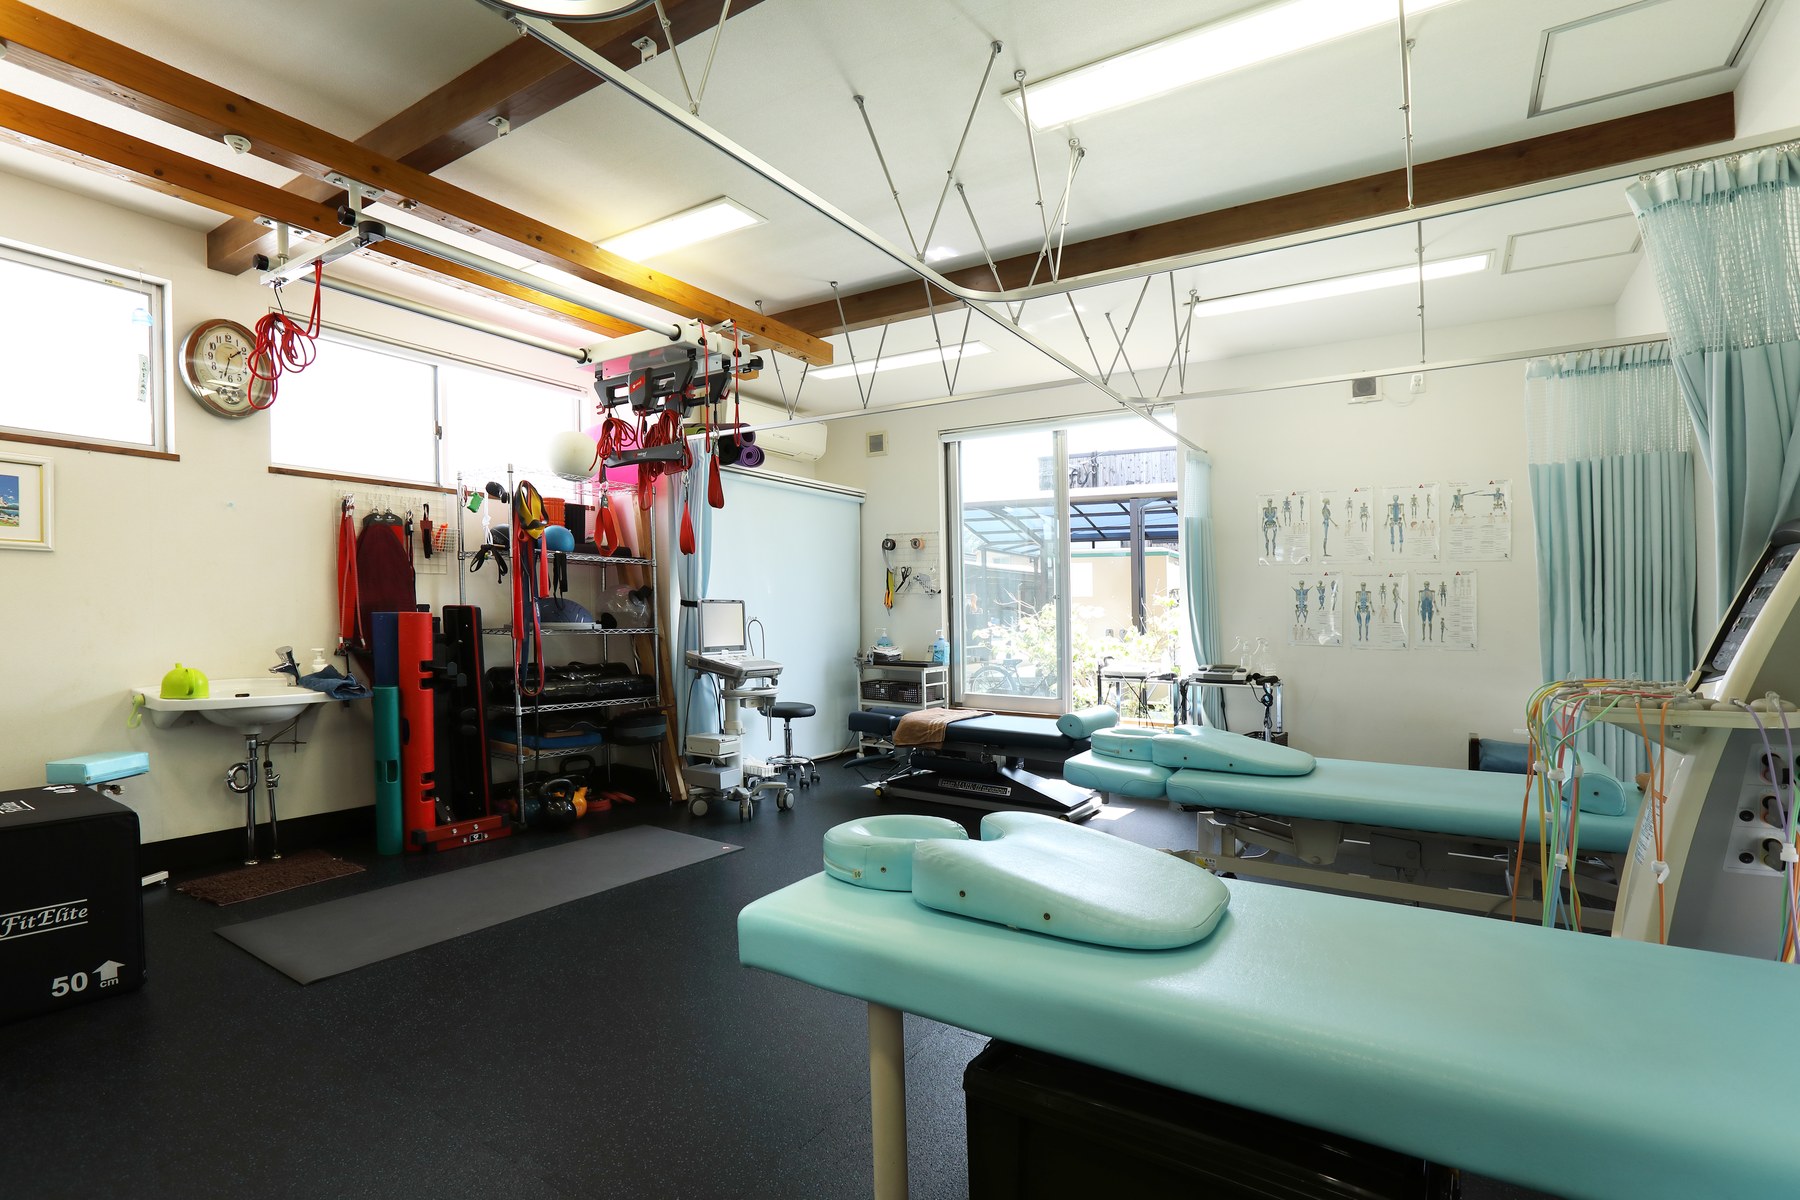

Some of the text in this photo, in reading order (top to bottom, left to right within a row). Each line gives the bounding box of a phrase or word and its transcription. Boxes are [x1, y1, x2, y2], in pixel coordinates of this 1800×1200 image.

[216, 335, 222, 343] 11
[225, 335, 232, 343] 12
[209, 342, 216, 350] 10
[241, 347, 247, 355] 2
[208, 352, 214, 360] 9
[211, 362, 217, 370] 8
[227, 375, 233, 383] 6
[237, 373, 242, 382] 5
[0, 907, 88, 938] FitElite
[51, 972, 119, 997] 50 cm
